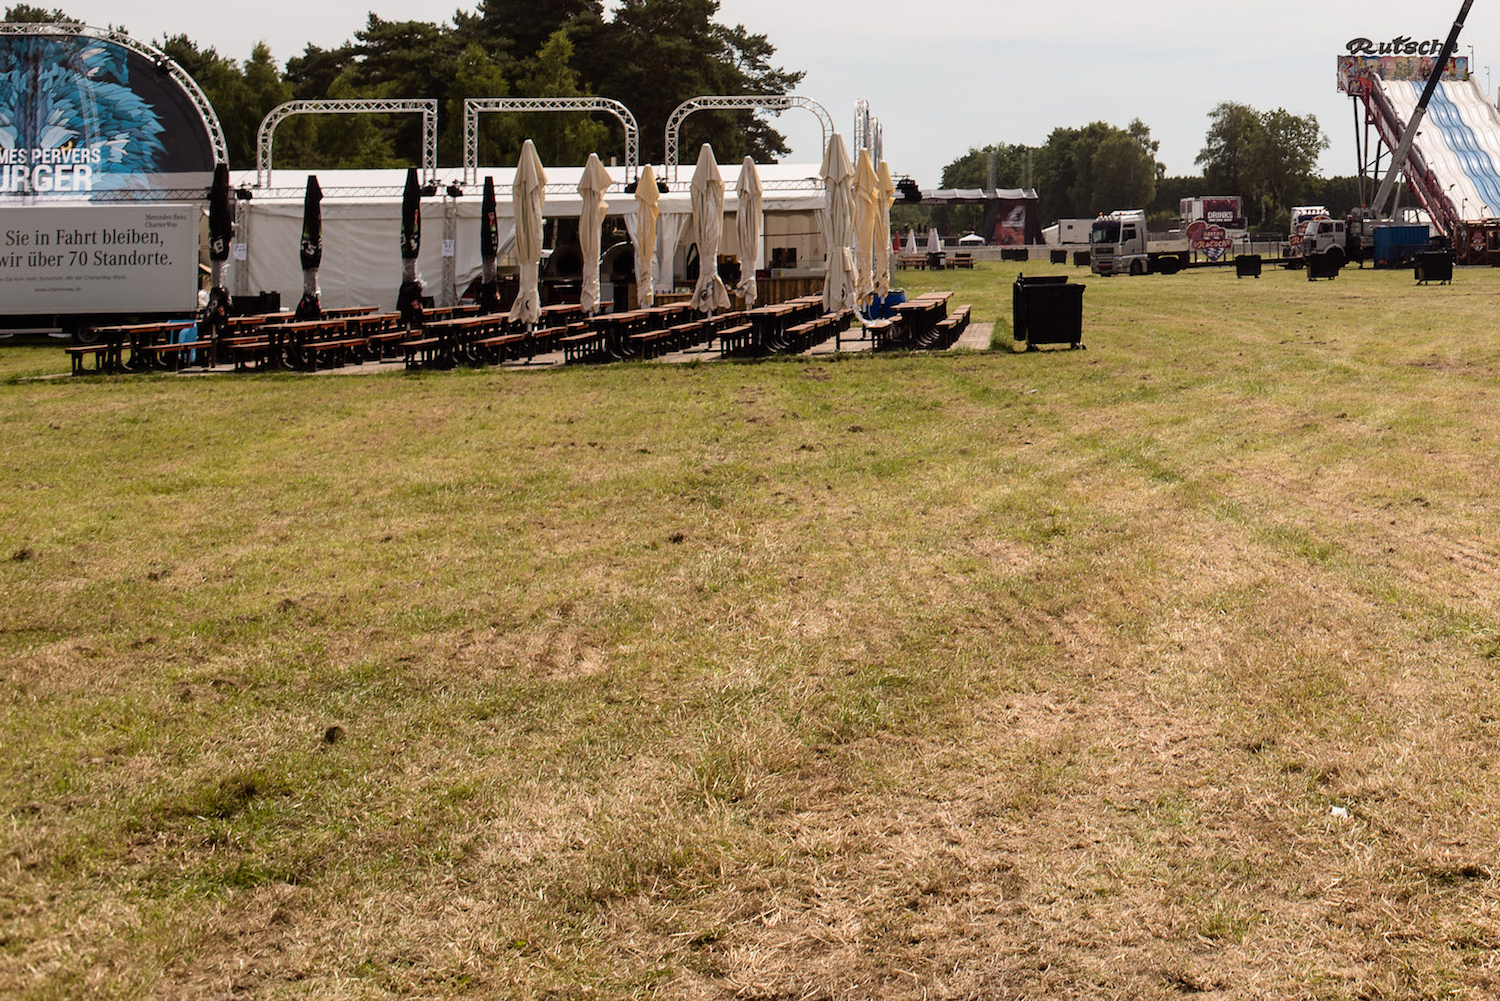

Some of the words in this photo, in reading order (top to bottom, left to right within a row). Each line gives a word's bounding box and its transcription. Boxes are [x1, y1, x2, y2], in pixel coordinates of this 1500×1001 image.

[31, 148, 100, 164] PERVERS
[5, 230, 29, 246] Sie
[35, 230, 50, 245] in
[56, 229, 97, 245] Fahrt
[102, 229, 164, 247] bleiben,
[0, 252, 23, 267] wir
[28, 252, 64, 267] über
[69, 251, 88, 267] 70
[93, 250, 172, 266] Standorte.
